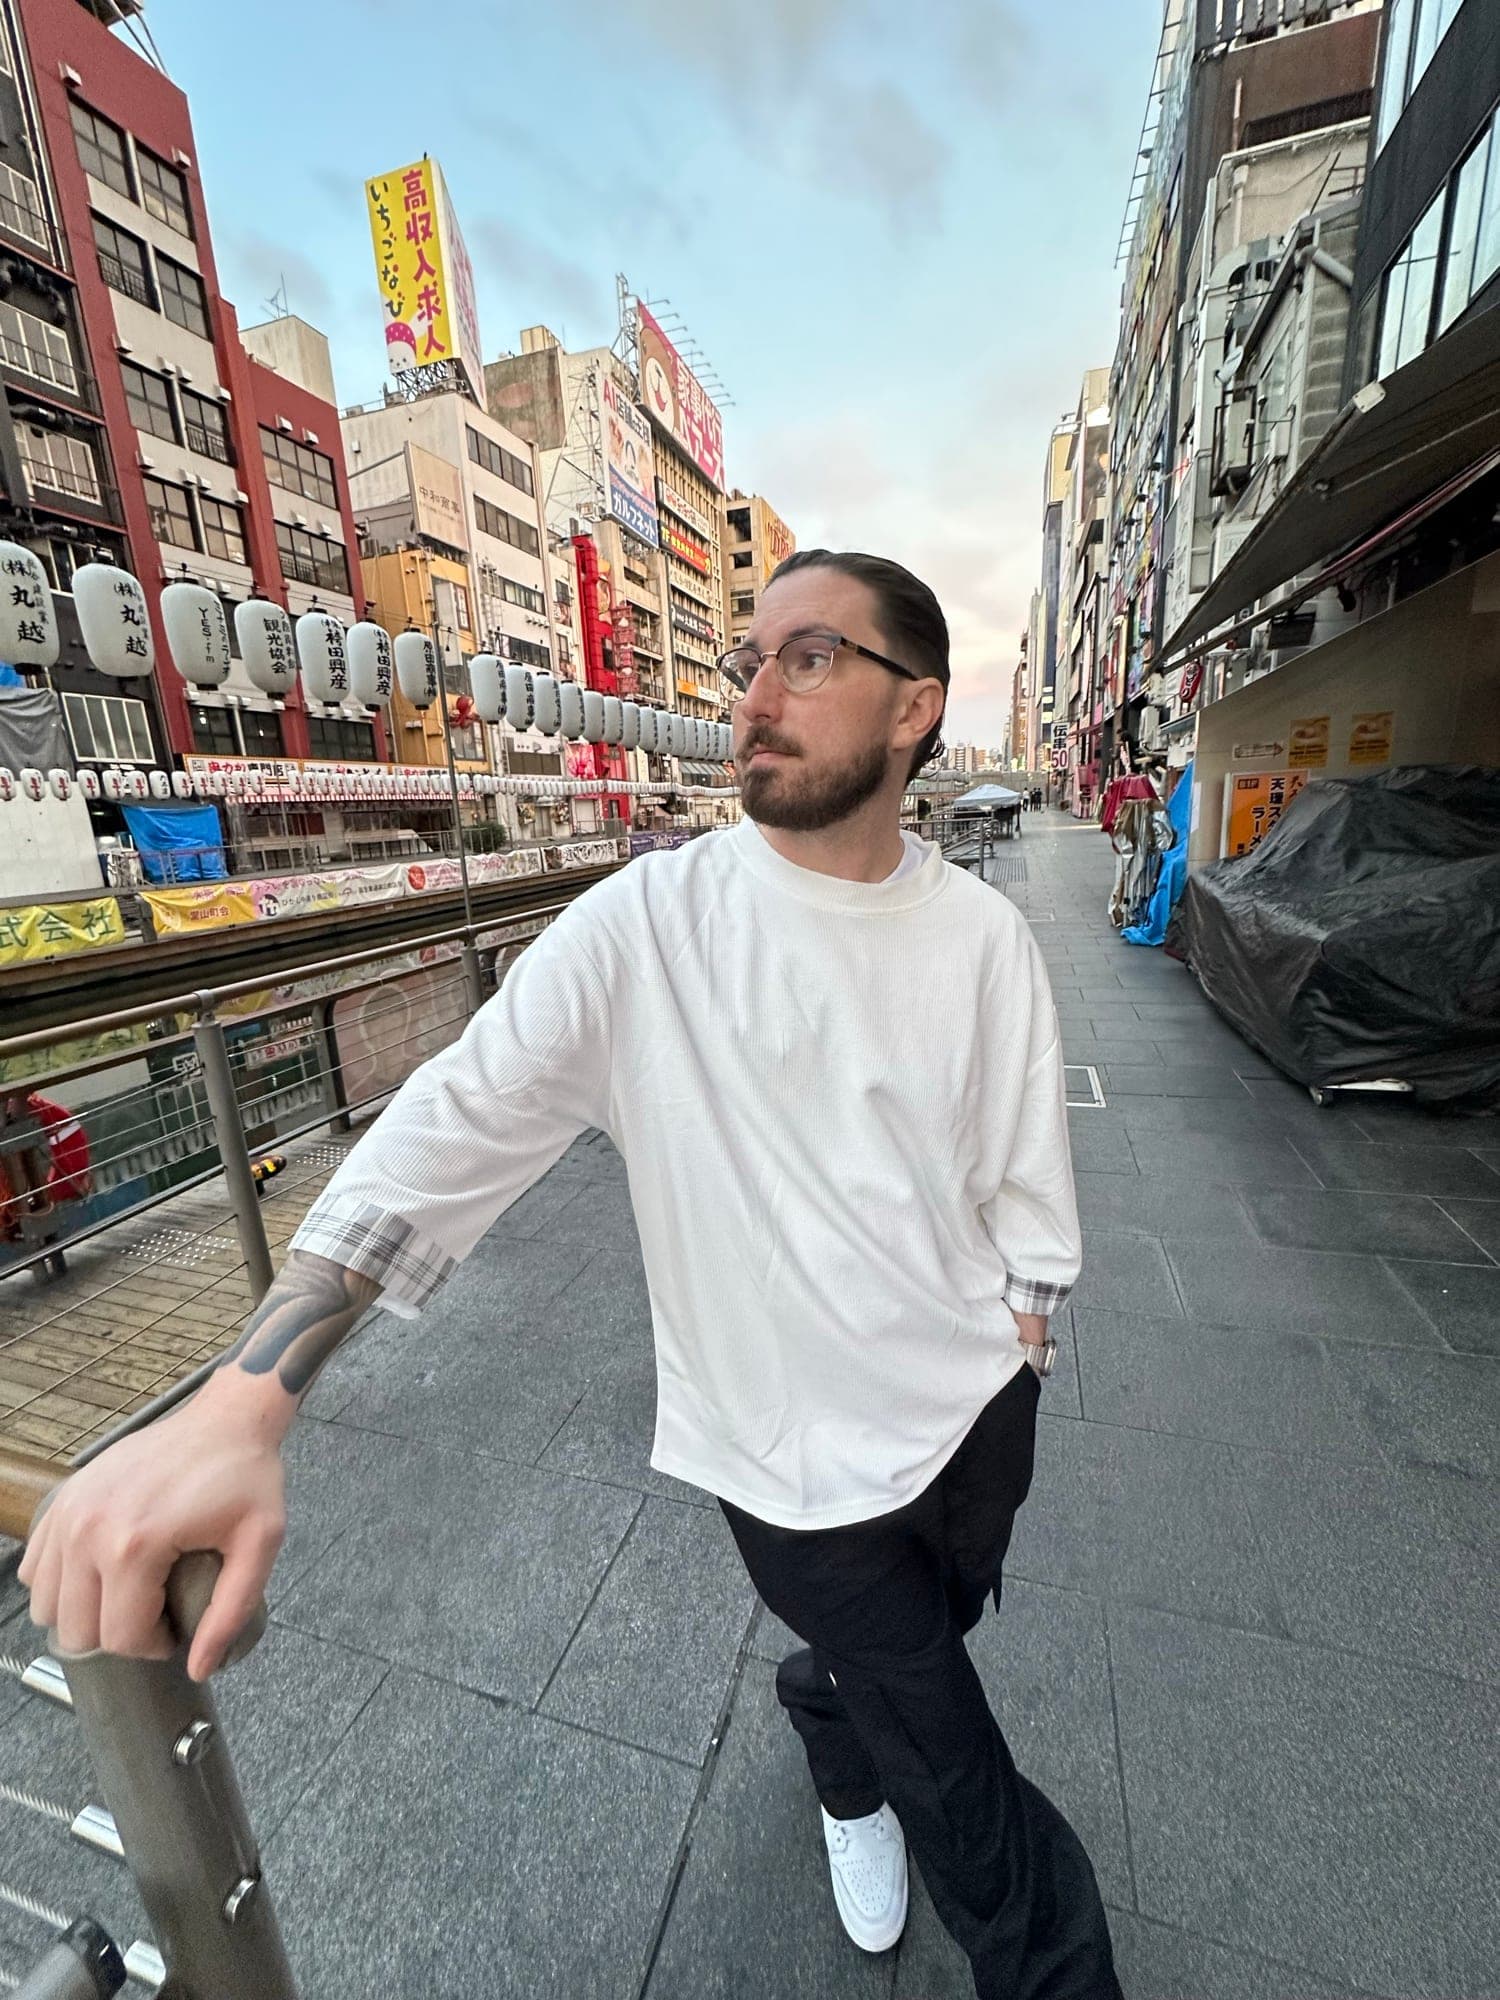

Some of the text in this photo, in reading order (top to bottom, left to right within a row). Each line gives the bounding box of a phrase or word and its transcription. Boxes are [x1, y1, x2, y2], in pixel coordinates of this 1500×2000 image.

[370, 180, 406, 318] いちごなび
[402, 168, 446, 358] 高収入求人
[1051, 750, 1068, 769] 50
